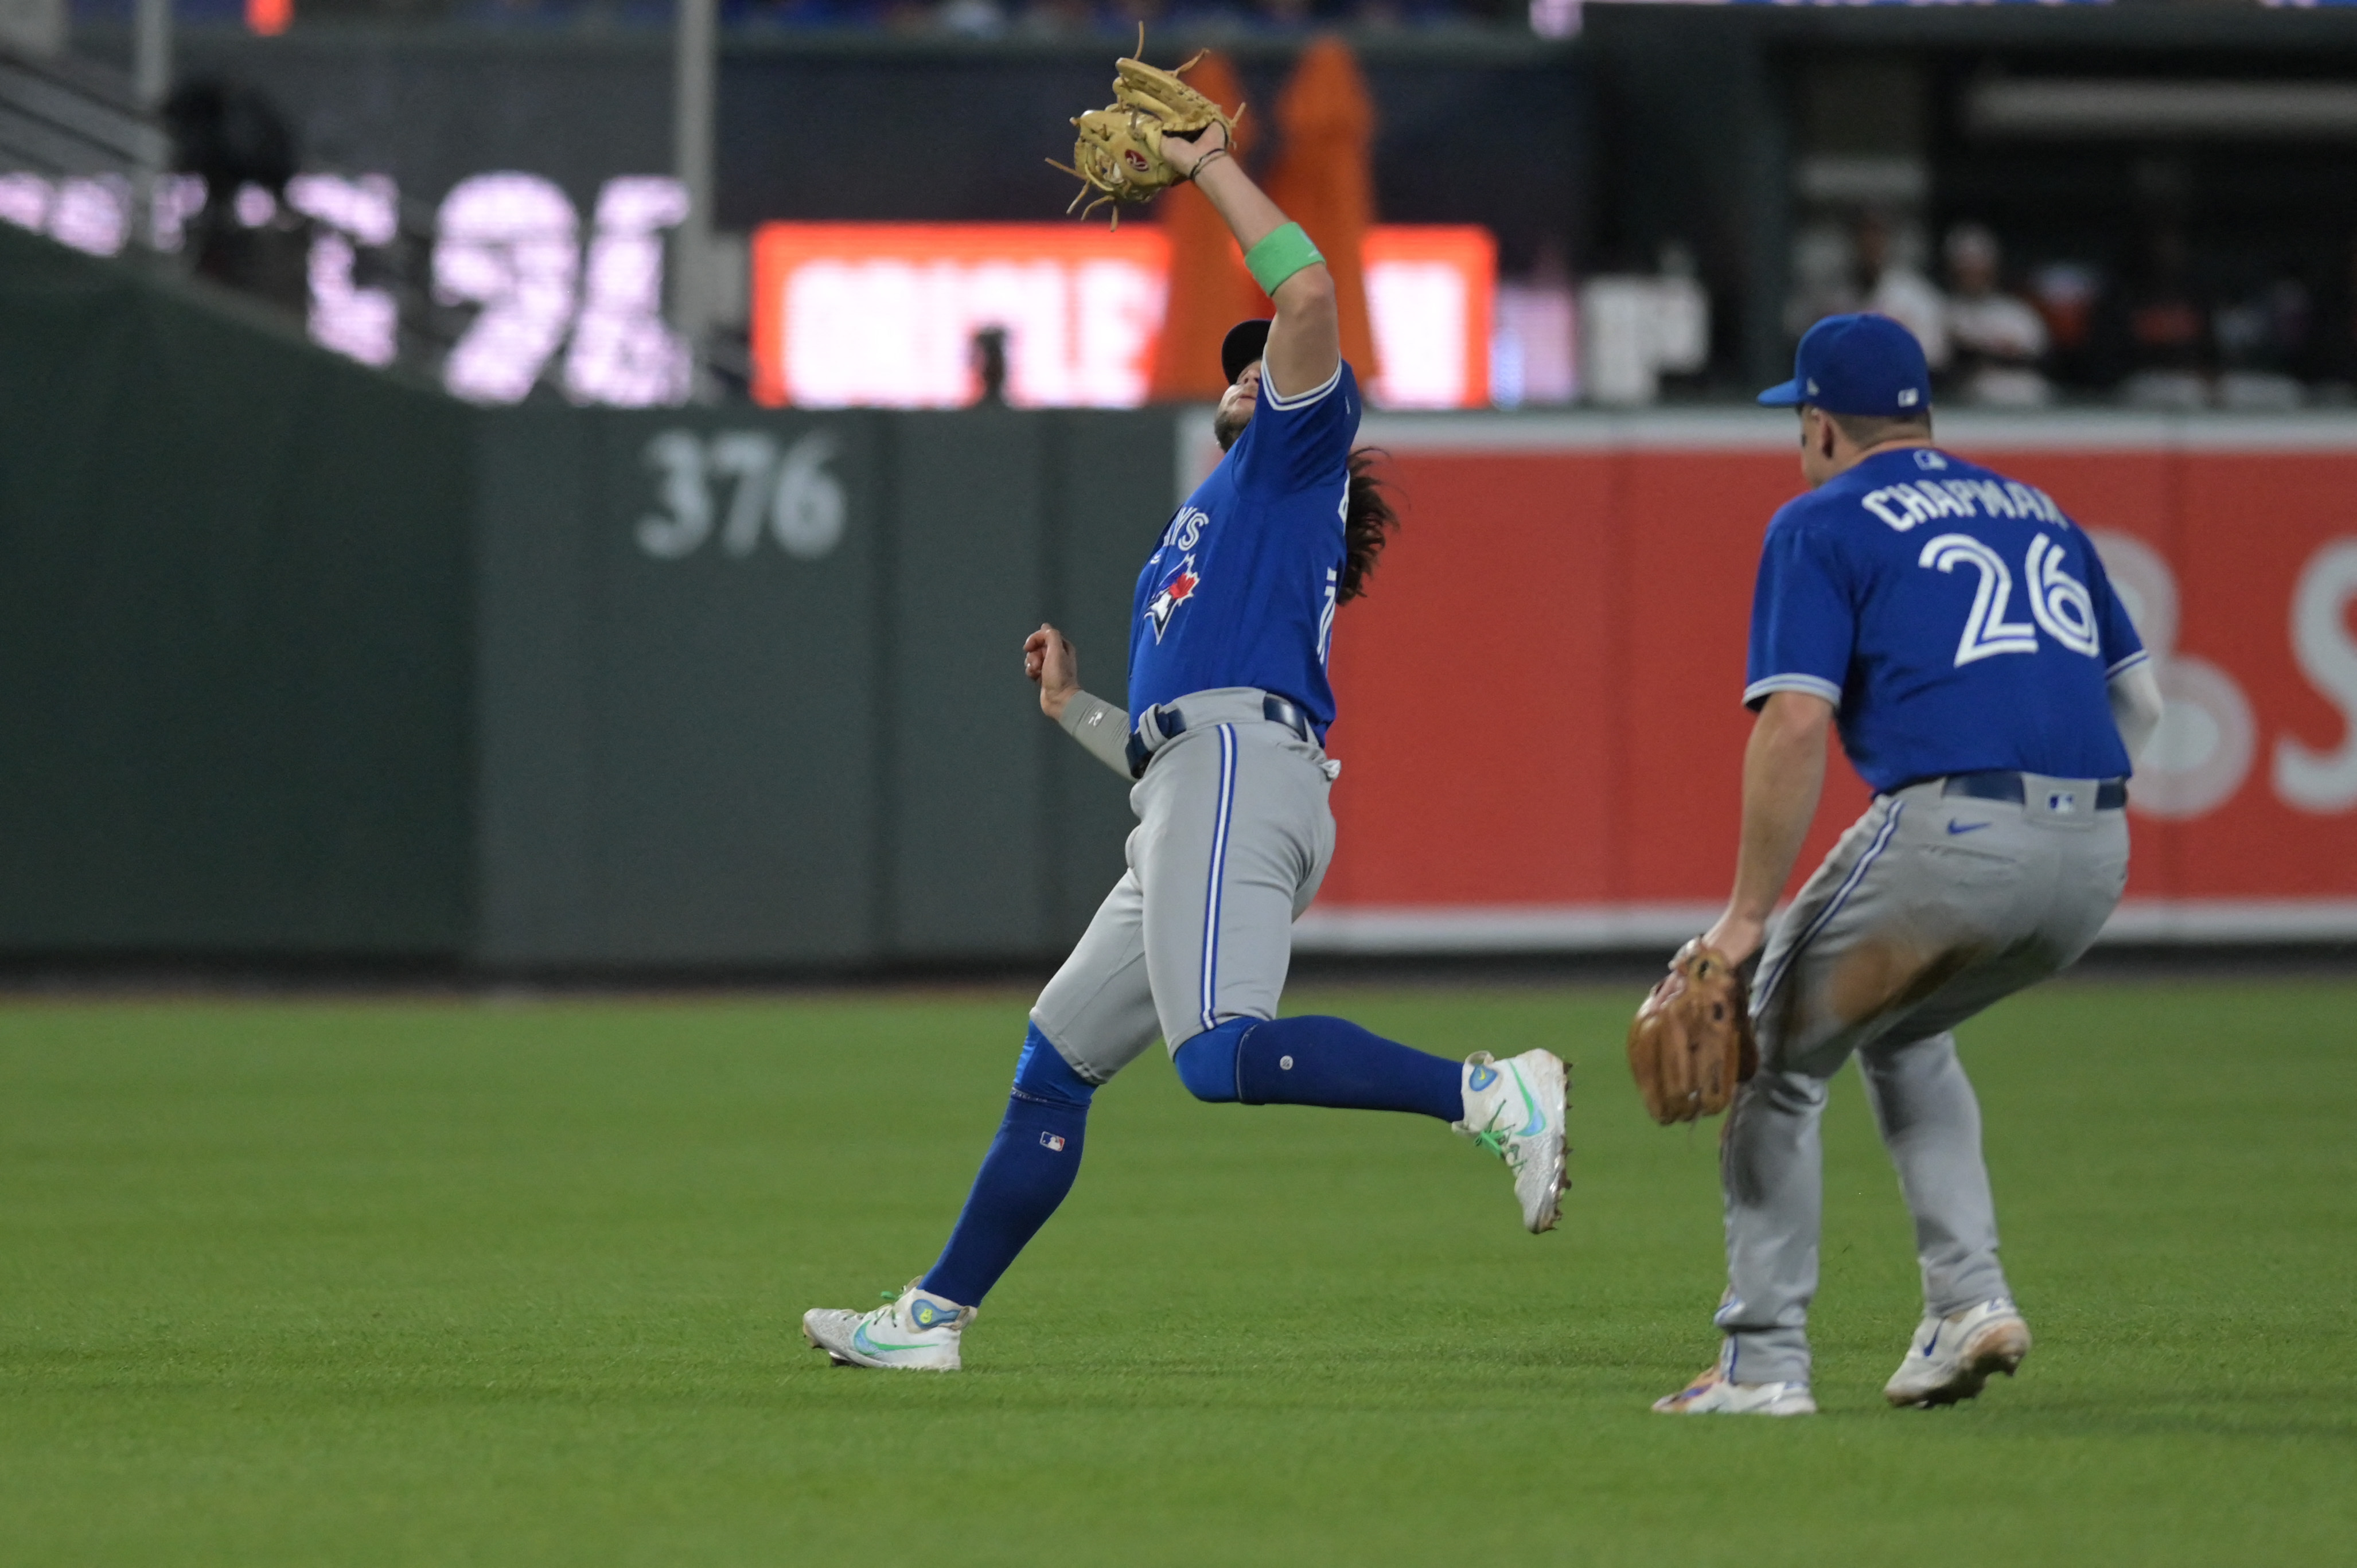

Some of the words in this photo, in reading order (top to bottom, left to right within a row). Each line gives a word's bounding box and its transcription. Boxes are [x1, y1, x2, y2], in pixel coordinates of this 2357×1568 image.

[634, 431, 844, 559] 376
[1862, 480, 2068, 532] CHAPMAN
[1919, 533, 2099, 667] 26
